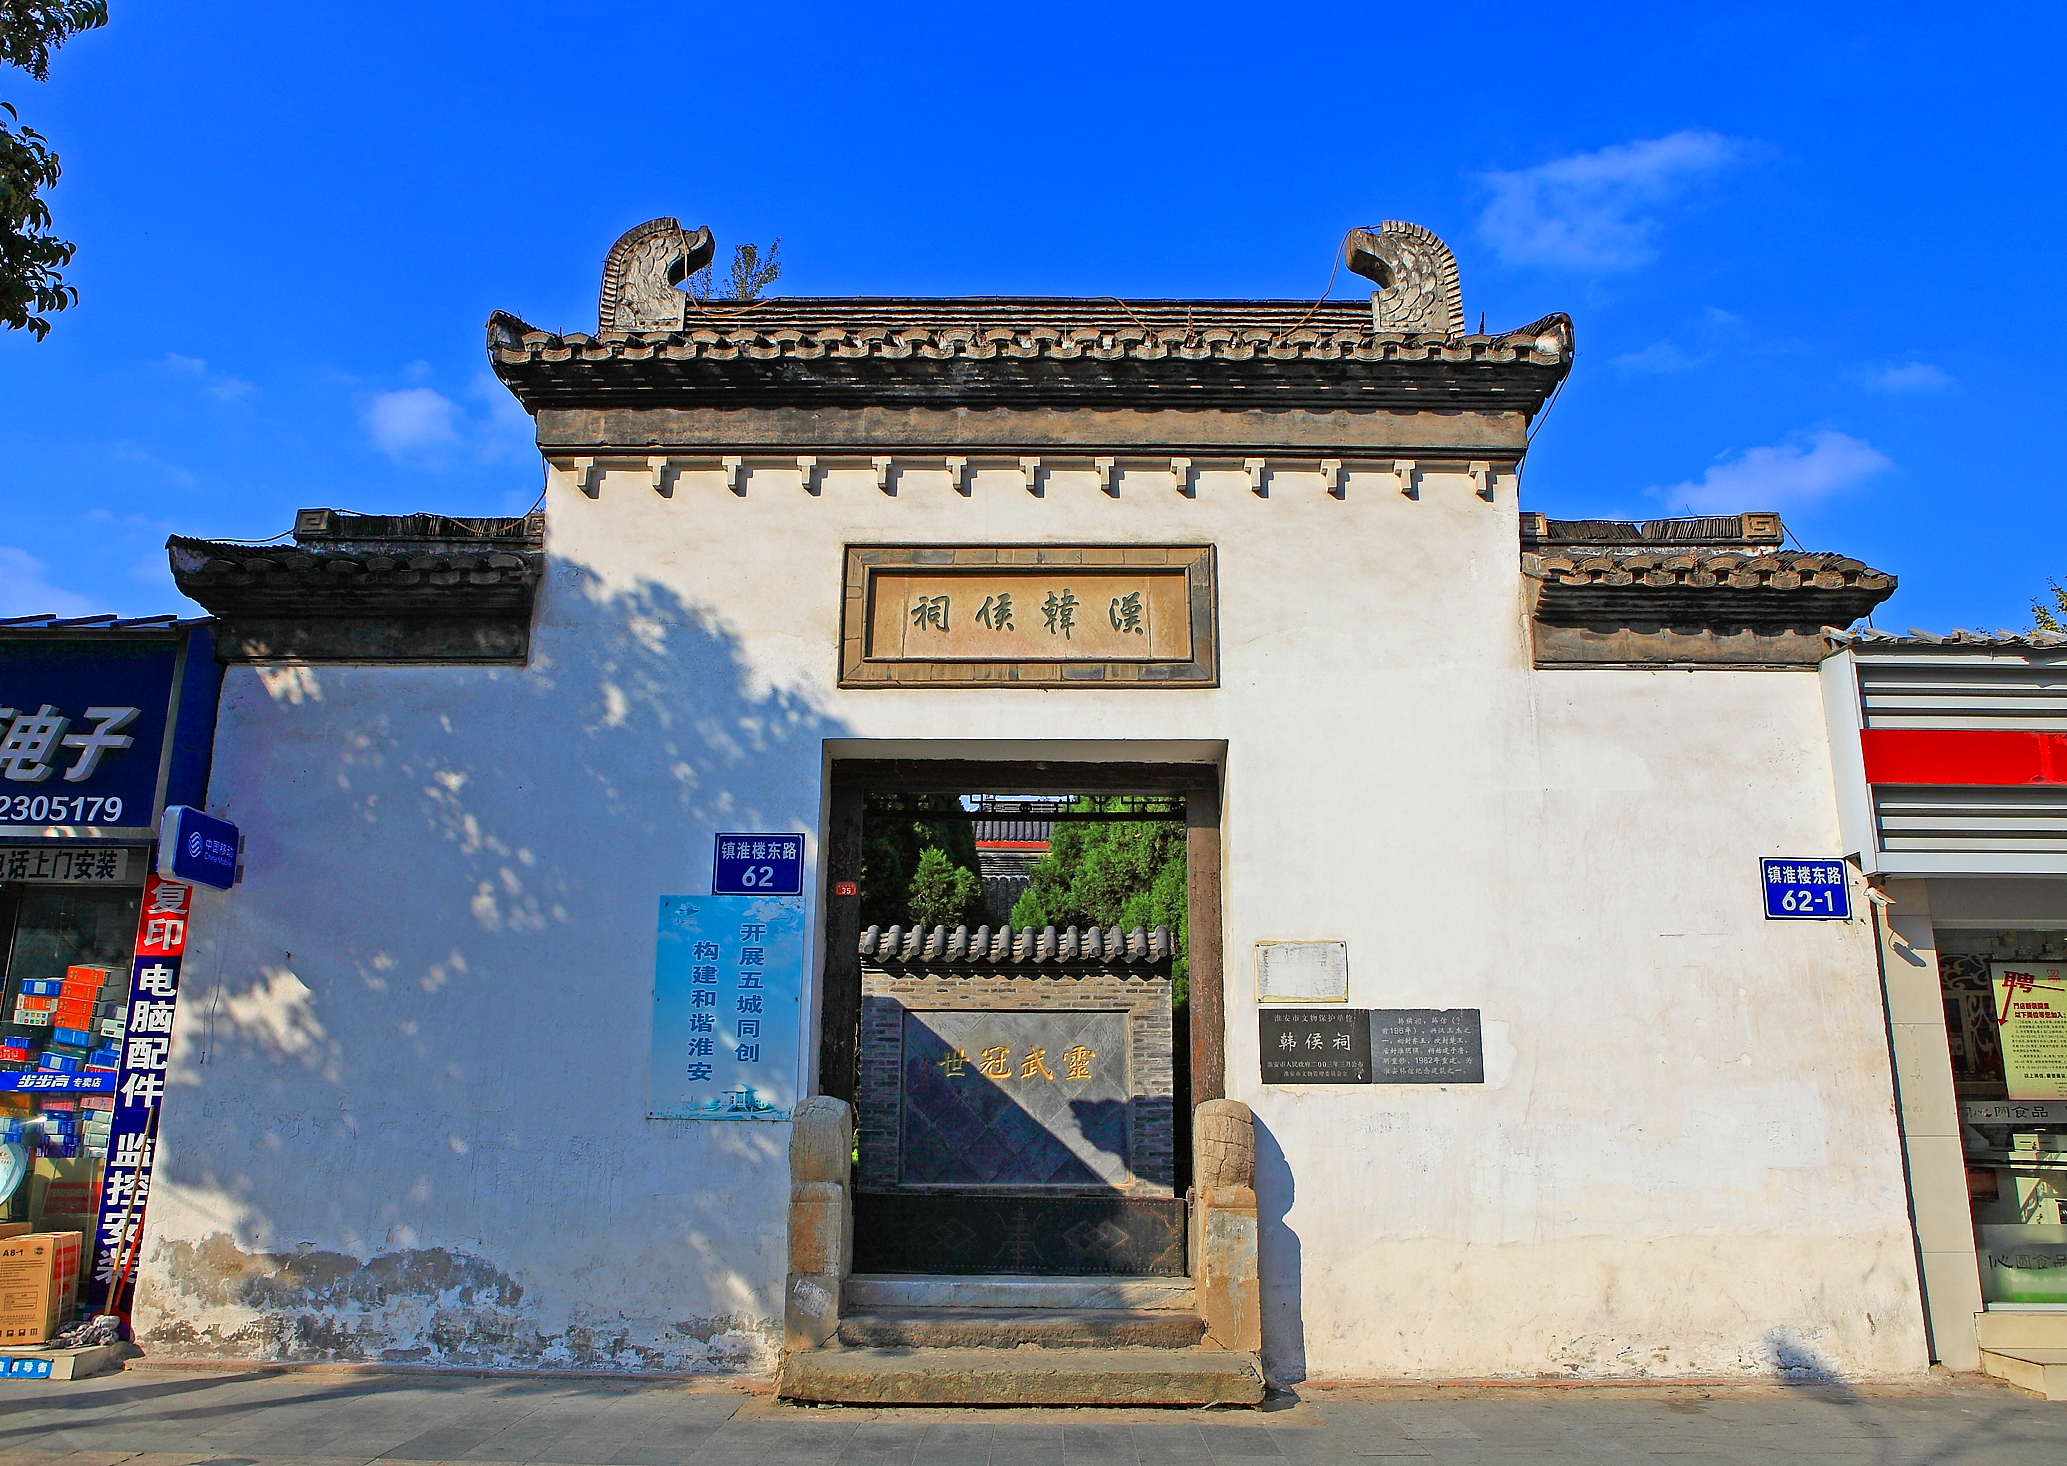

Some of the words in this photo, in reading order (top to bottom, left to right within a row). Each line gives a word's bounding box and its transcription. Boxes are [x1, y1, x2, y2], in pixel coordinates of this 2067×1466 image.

[0, 703, 141, 782] 电子
[205, 839, 234, 858] 中国移动
[721, 841, 797, 860] 镇淮楼东路
[742, 866, 774, 887] 62
[1767, 865, 1841, 885] 镇淮楼东路
[1782, 890, 1834, 911] 62-1
[143, 882, 188, 950] 复印
[735, 923, 767, 1063] 开展五城同创
[687, 941, 719, 1082] 构建和谐淮安
[120, 963, 177, 1108] 电脑配件
[1278, 1031, 1351, 1052] 韩侯祠
[17, 1075, 70, 1088] 步步高
[73, 1077, 102, 1088] 专卖店
[95, 1132, 155, 1285] 监控安装
